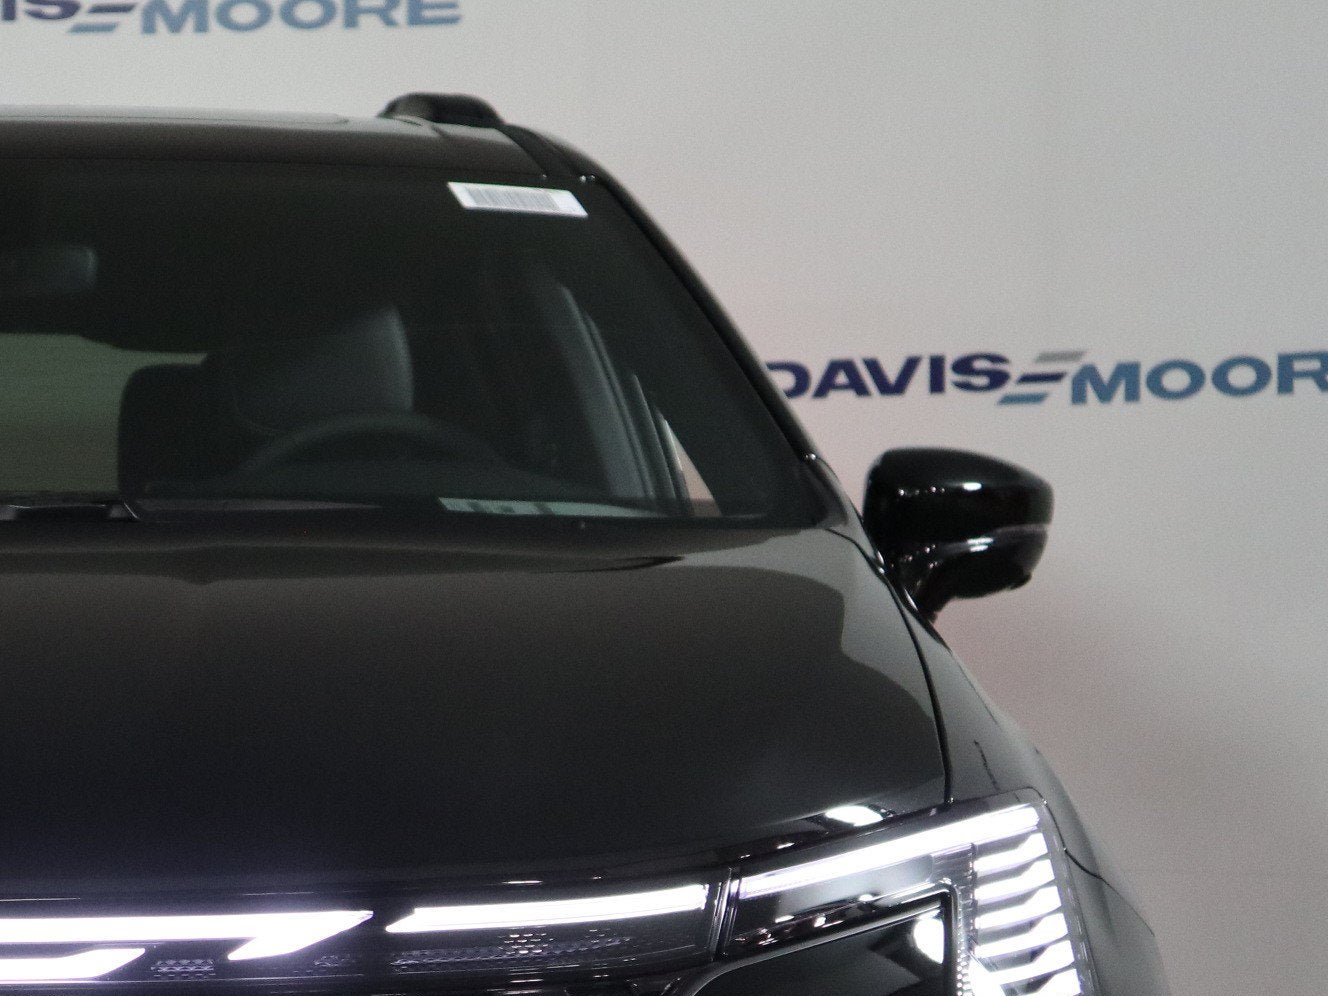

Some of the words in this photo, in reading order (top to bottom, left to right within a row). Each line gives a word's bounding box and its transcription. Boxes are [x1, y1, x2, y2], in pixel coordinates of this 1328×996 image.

[141, 0, 462, 33] MOORE
[765, 352, 1011, 399] DAVIS
[1070, 350, 1328, 405] MOOR
